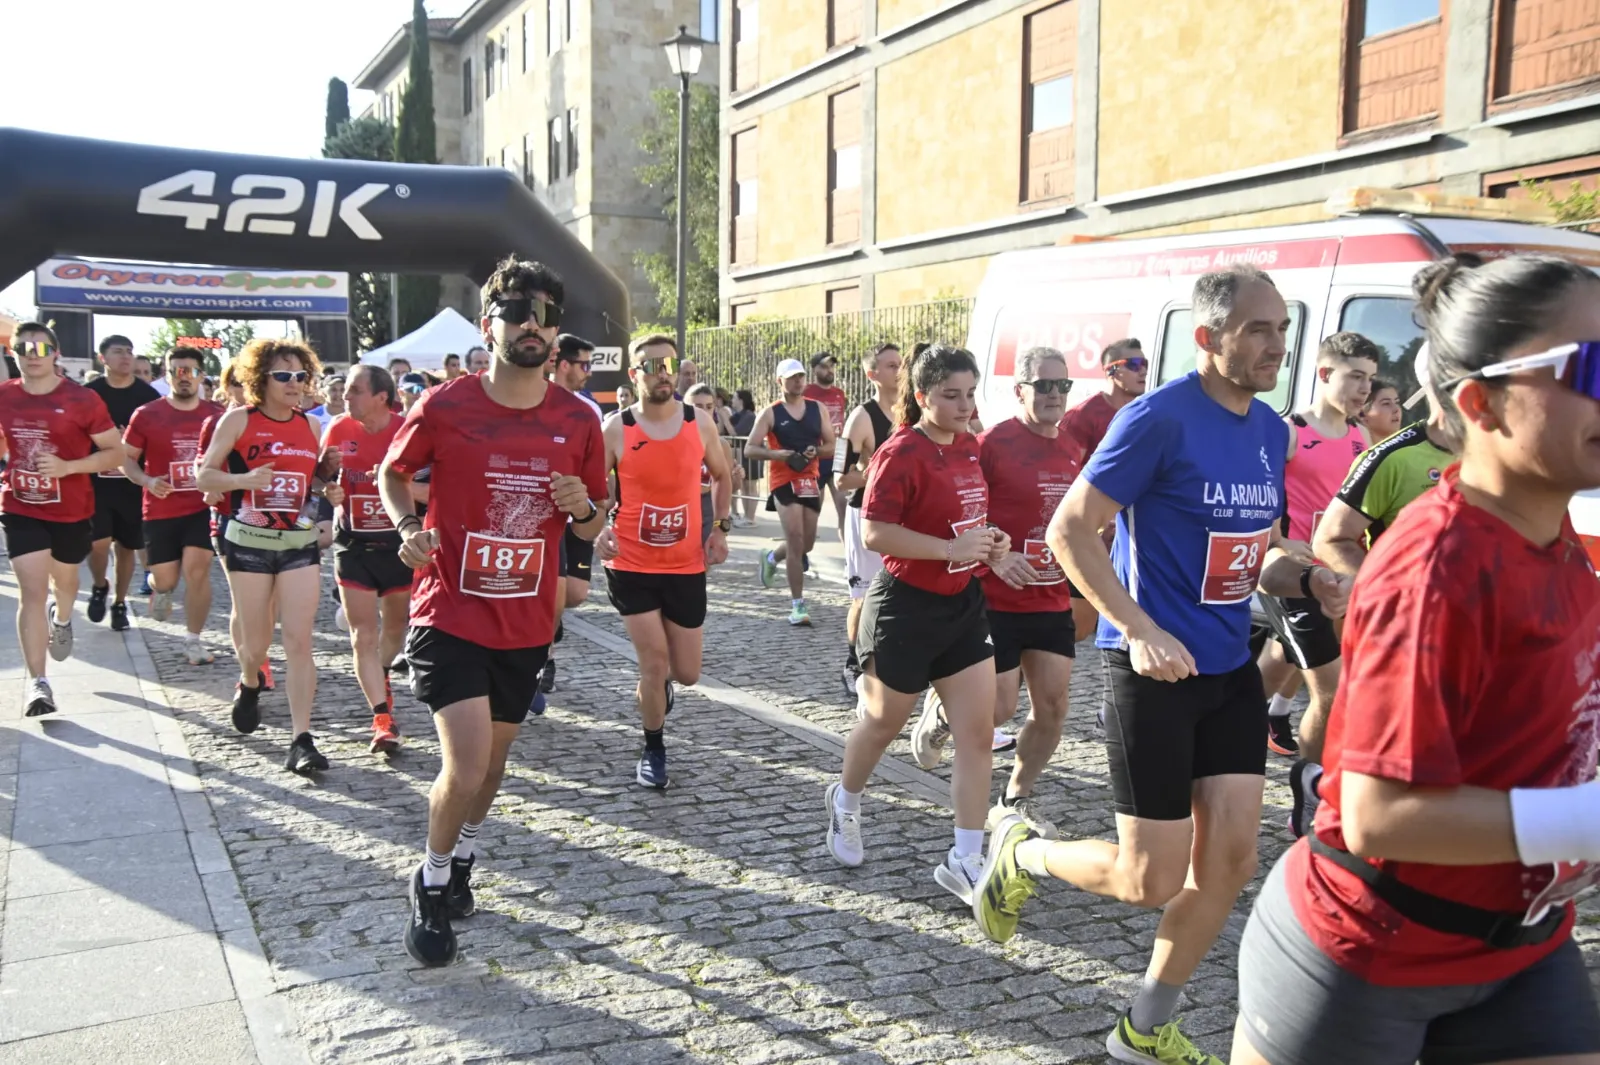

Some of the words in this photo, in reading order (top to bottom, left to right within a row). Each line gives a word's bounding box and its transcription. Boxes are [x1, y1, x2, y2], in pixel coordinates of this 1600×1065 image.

[1213, 248, 1278, 266] Auxilios
[53, 262, 338, 292] OrycronSport
[84, 292, 313, 309] www.orycronsport.com
[591, 352, 619, 365] 2K
[176, 466, 195, 478] 18
[17, 474, 52, 489] 193
[1203, 481, 1226, 505] LA
[648, 511, 684, 529] 145
[1213, 508, 1234, 518] CLUB
[1240, 509, 1274, 520] DEPORTIVO
[476, 545, 534, 571] 187
[1040, 547, 1053, 564] 3
[1228, 542, 1259, 571] 28
